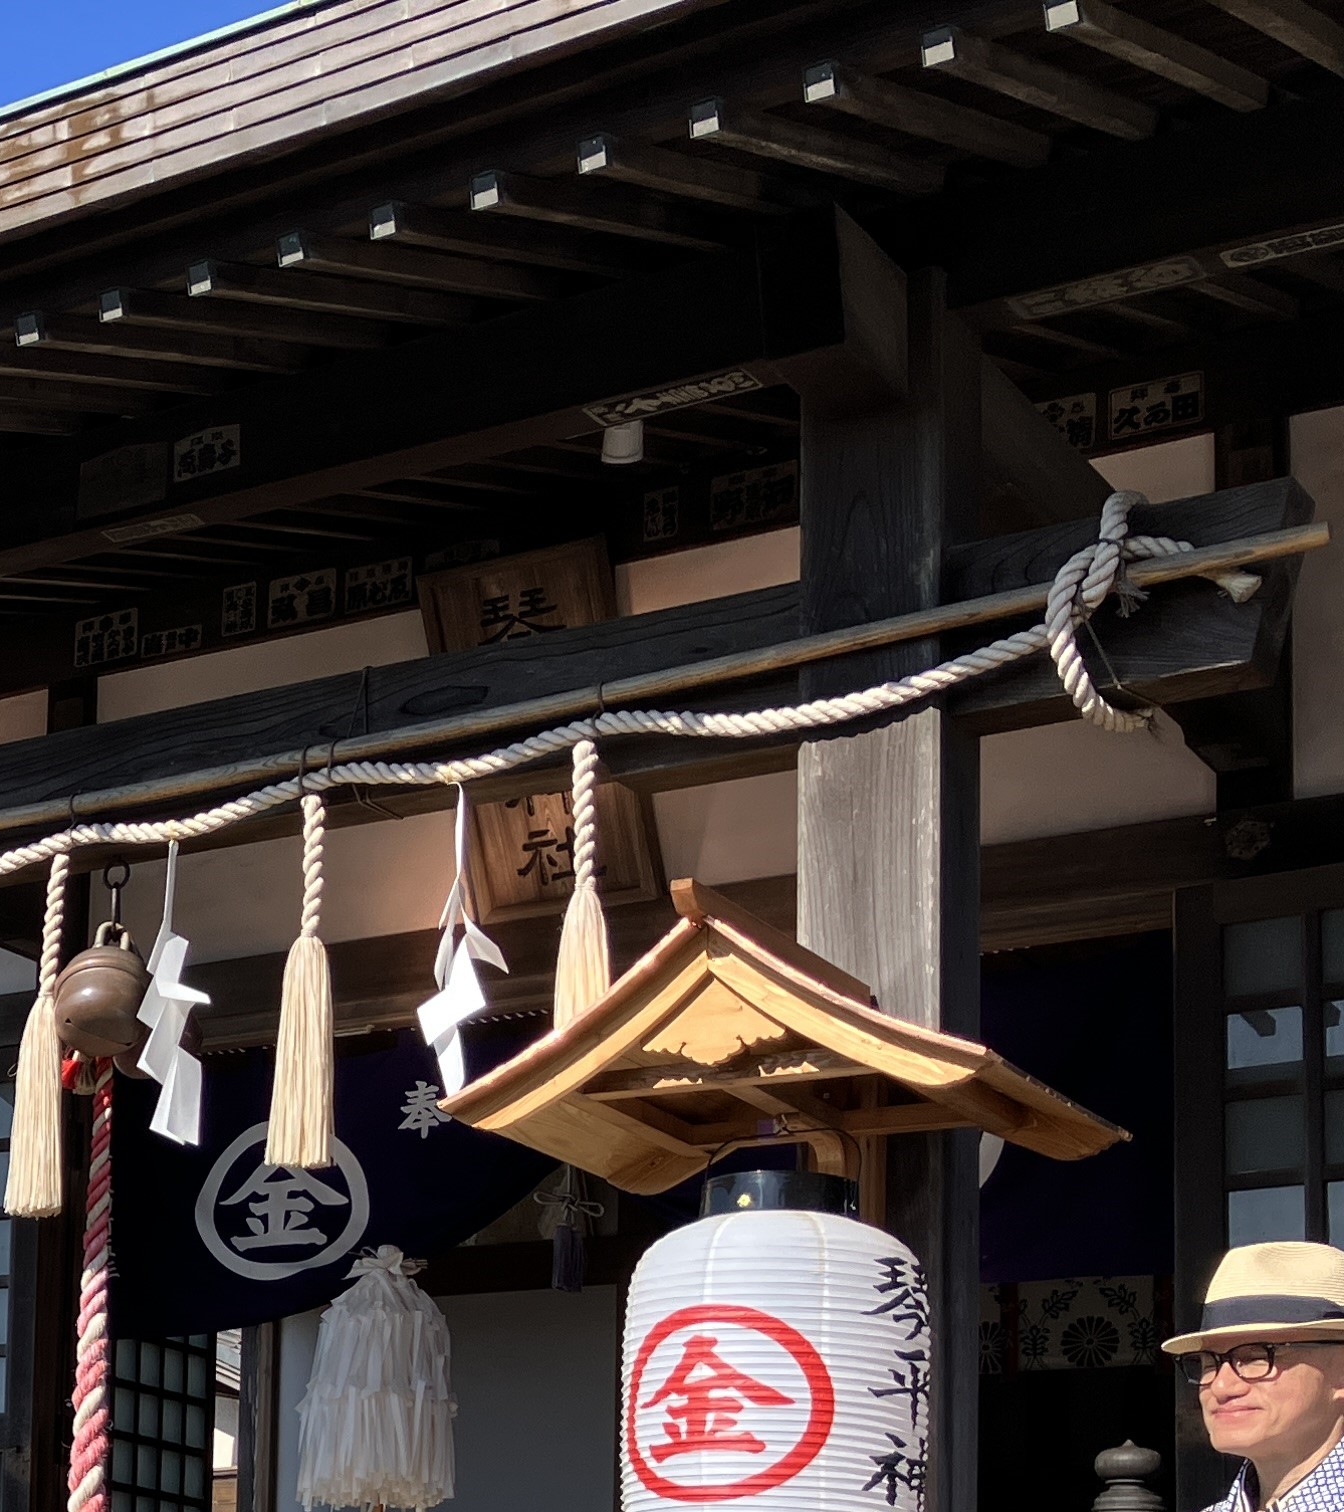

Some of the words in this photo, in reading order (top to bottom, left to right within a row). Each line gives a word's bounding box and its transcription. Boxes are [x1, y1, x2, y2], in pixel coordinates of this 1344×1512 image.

[398, 1080, 452, 1140] 奉
[219, 1166, 349, 1252] 金
[641, 1335, 795, 1464] 金
